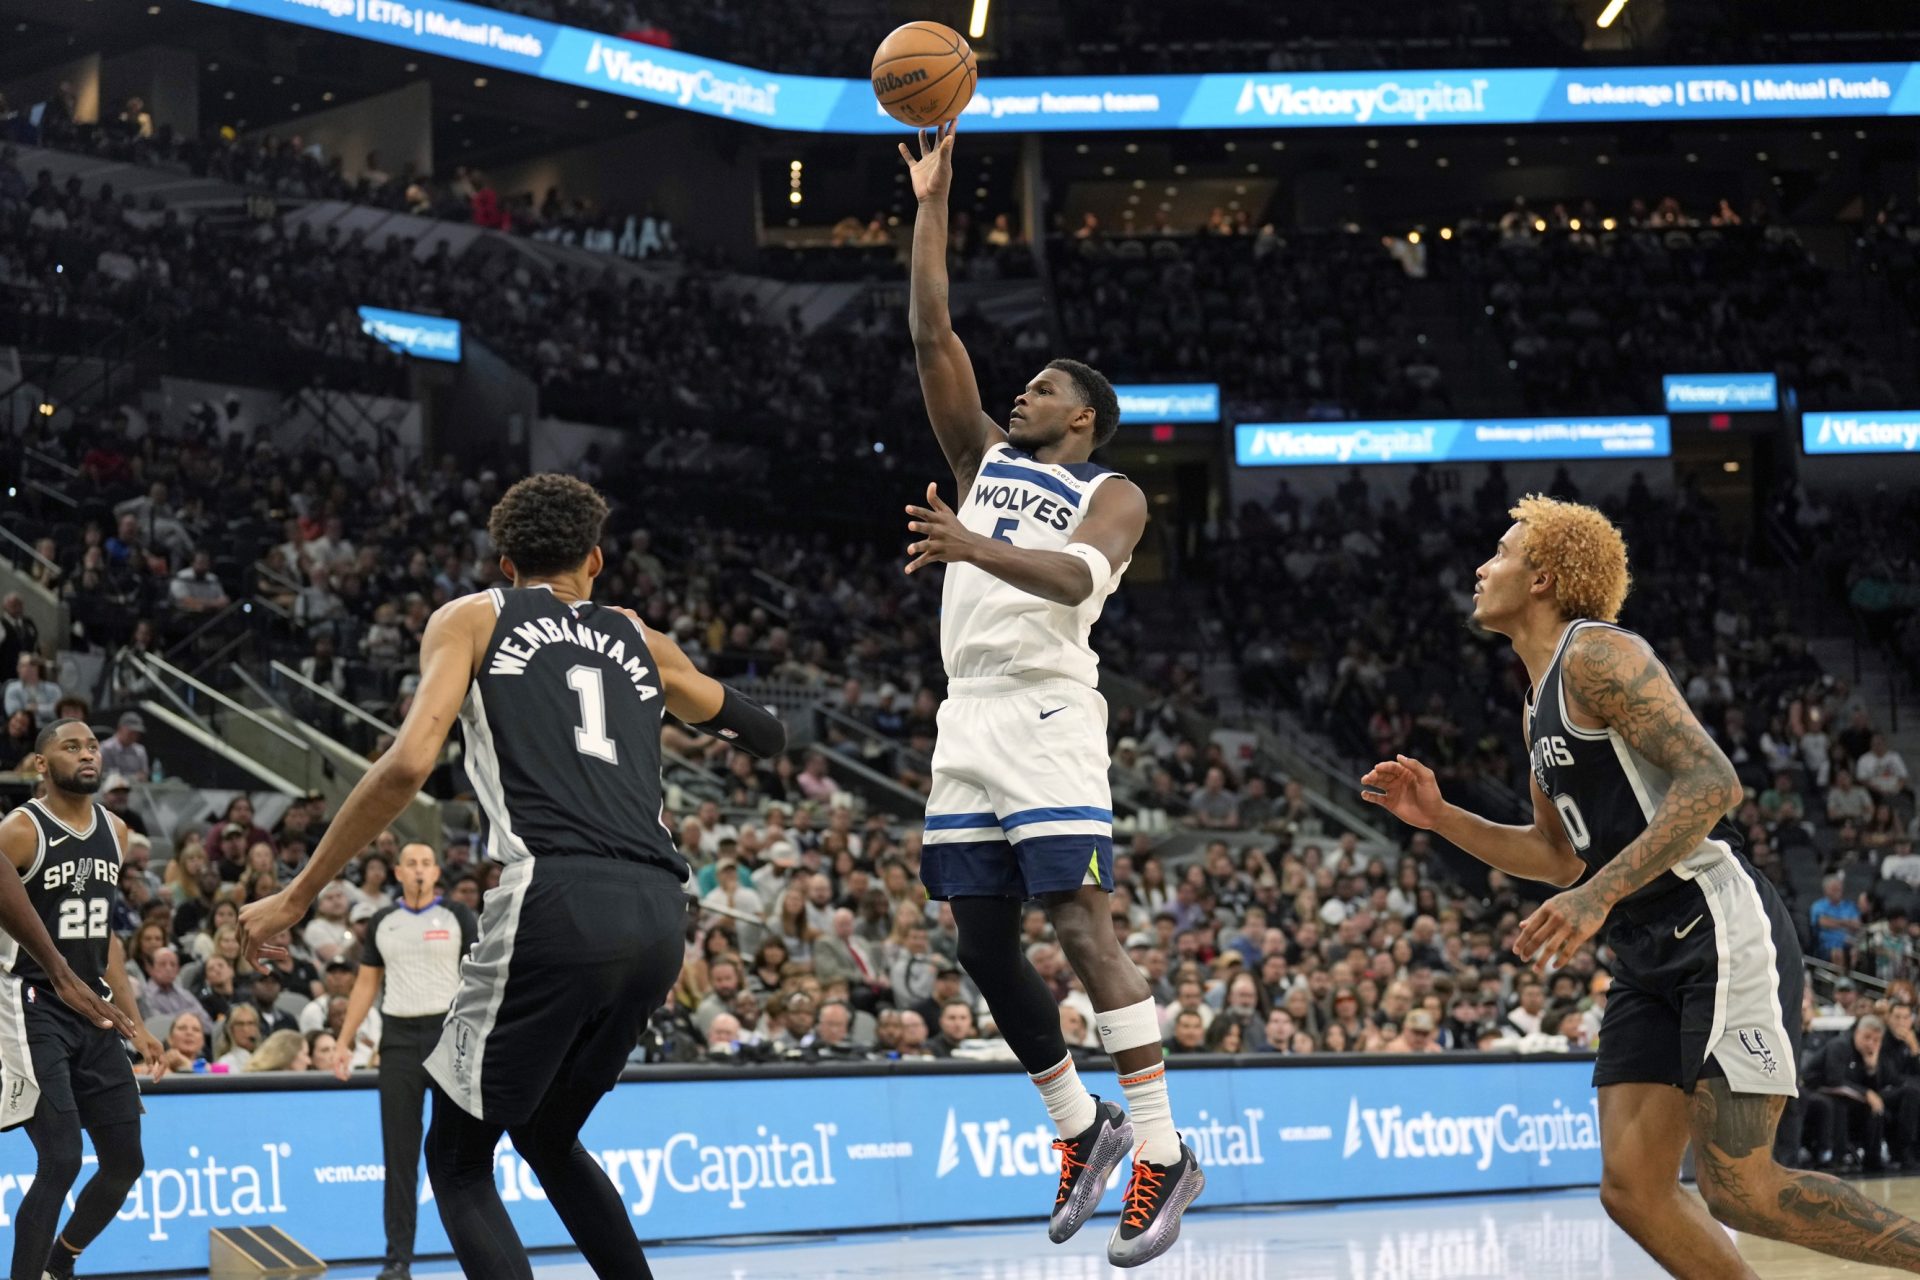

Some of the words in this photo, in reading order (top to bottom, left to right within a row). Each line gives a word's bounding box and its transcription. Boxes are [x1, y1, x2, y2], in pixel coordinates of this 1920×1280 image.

[425, 11, 488, 46] Mutual
[488, 25, 543, 58] Funds
[990, 96, 1039, 118] your
[1567, 83, 1673, 107] Brokerage
[1687, 80, 1738, 102] ETFs
[1753, 79, 1827, 101] Mutual
[1828, 77, 1891, 99] Funds
[975, 484, 1073, 531] WOLVES
[489, 617, 658, 701] WEMBANYAMA
[566, 664, 619, 765] 1
[44, 858, 119, 893] SPURS
[58, 898, 109, 939] 22
[846, 1142, 913, 1159] vcm.com
